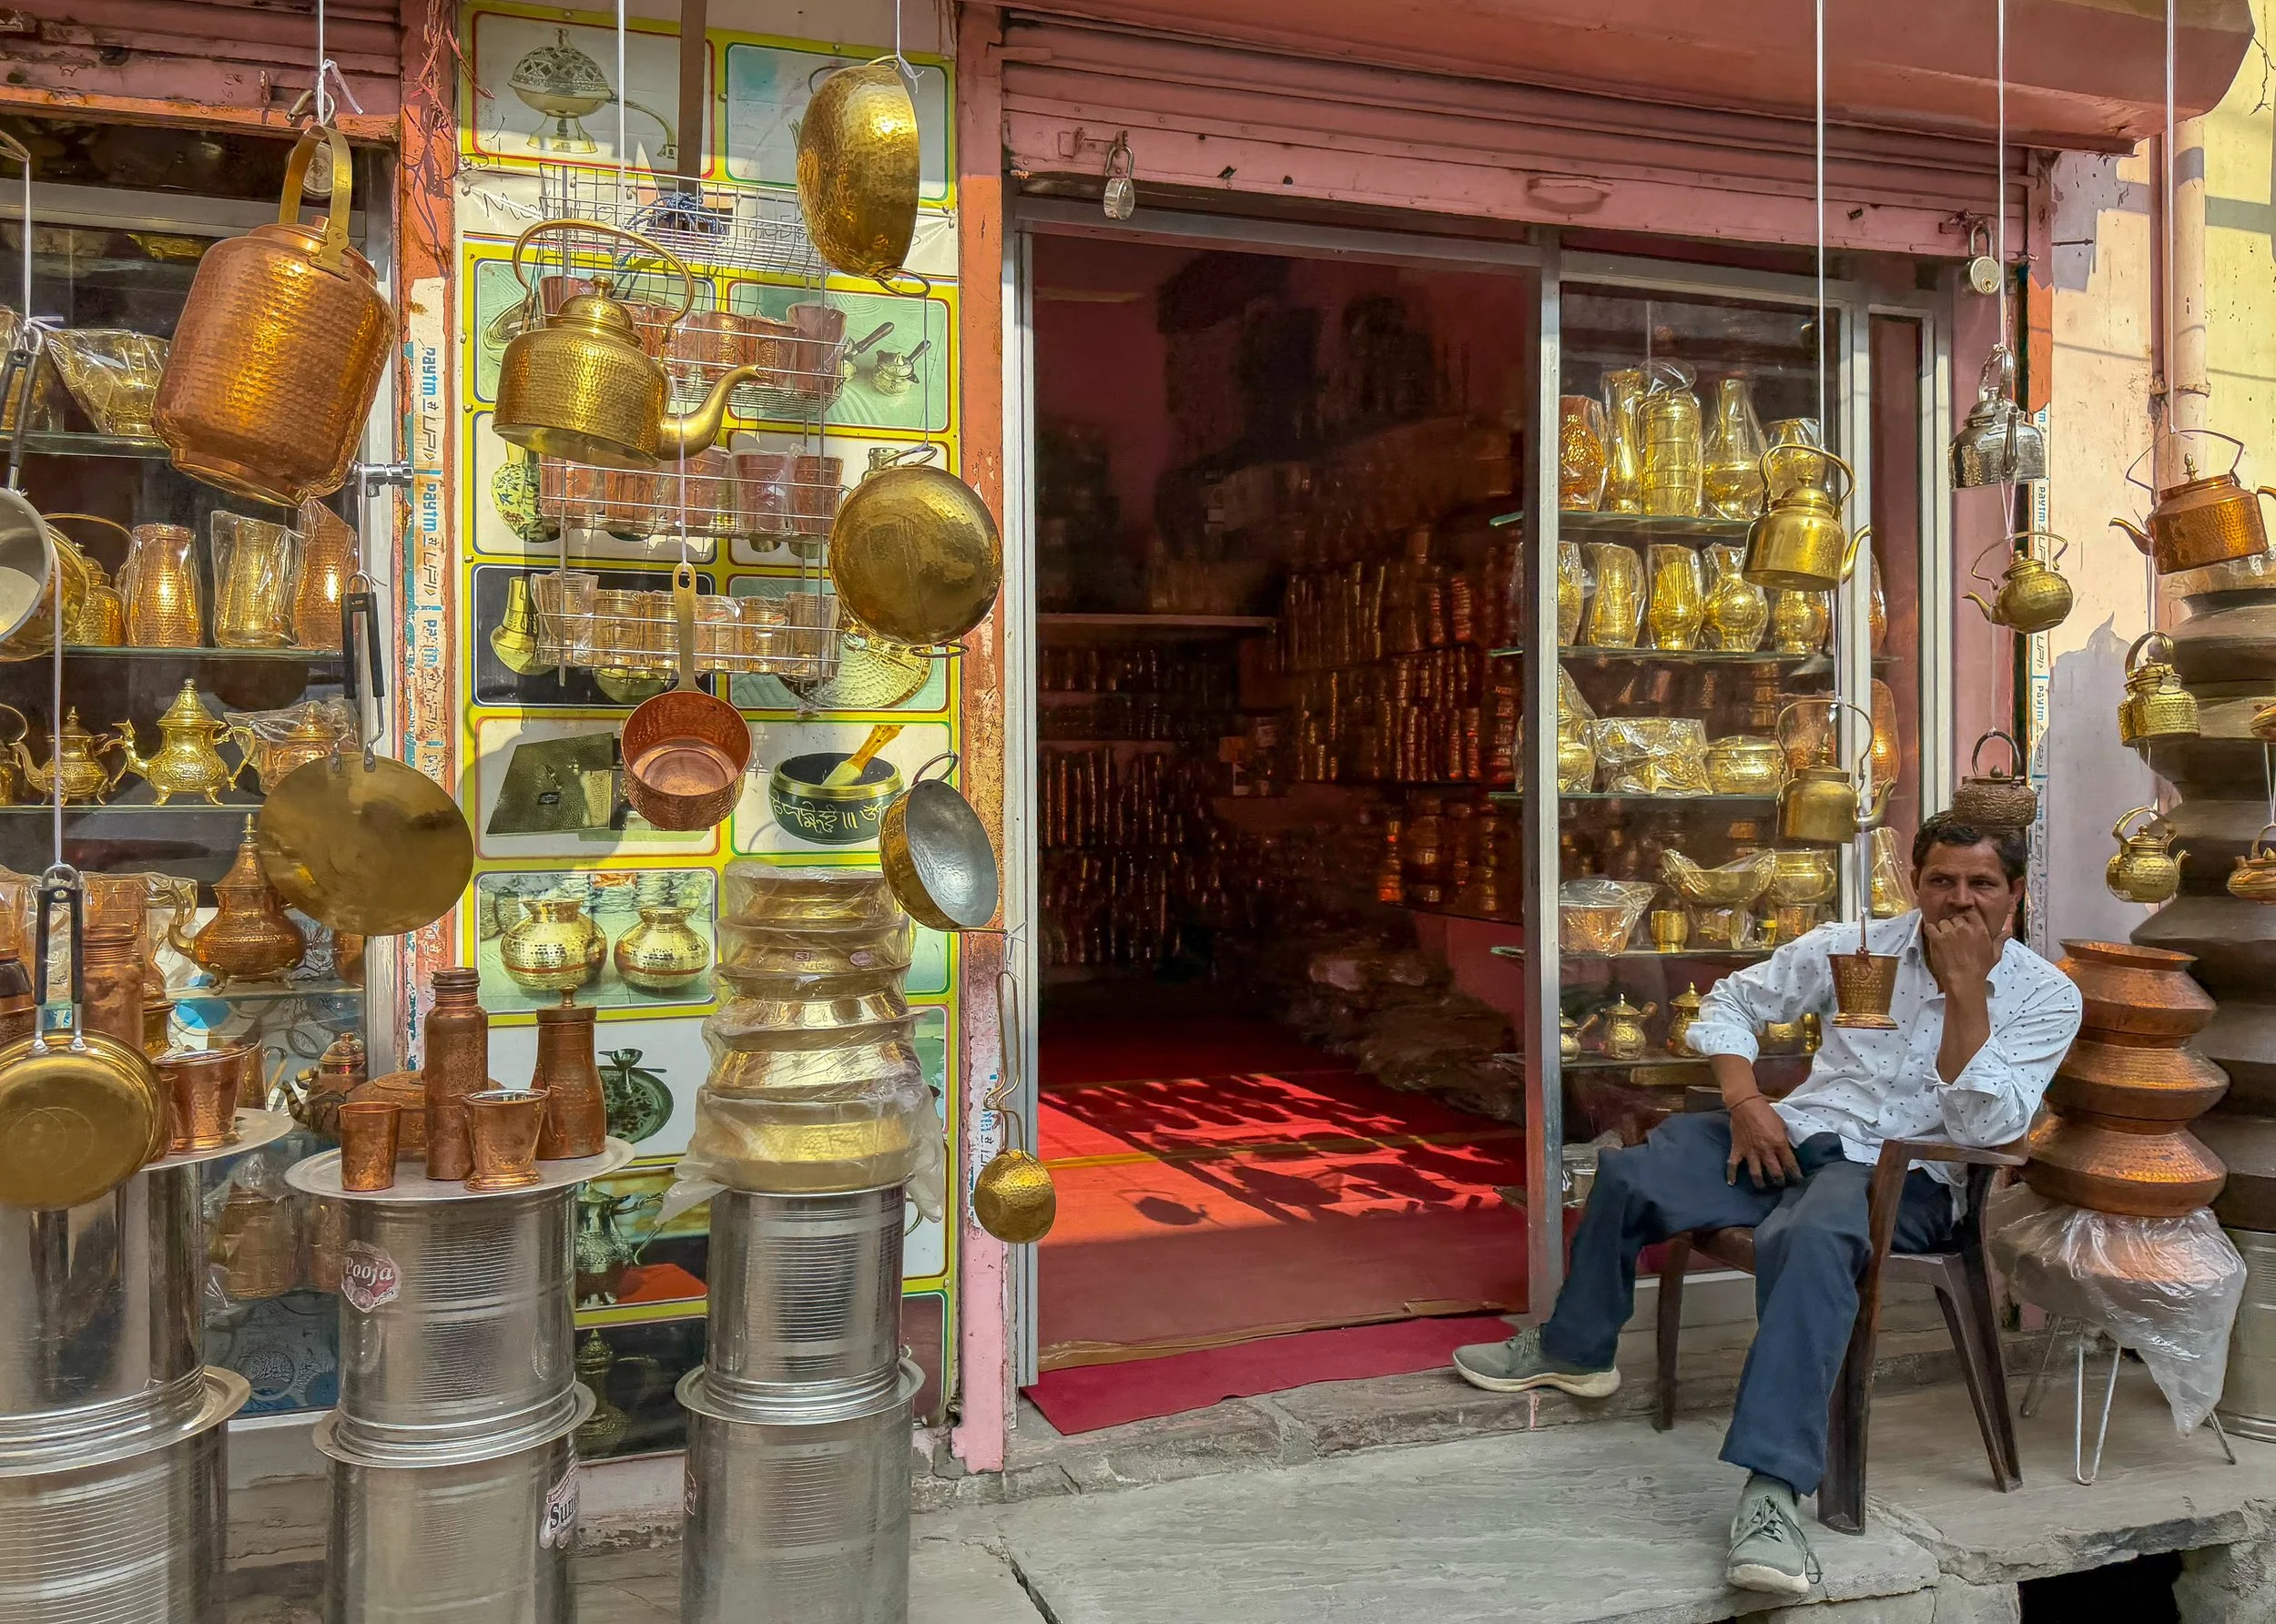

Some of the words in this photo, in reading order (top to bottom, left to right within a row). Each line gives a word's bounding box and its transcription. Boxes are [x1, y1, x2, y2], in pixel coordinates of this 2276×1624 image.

[422, 346, 440, 396] paytm
[422, 482, 439, 533] paytm
[2037, 485, 2047, 523] paytm
[2037, 685, 2046, 721] paytm
[344, 1256, 394, 1286] Pooja
